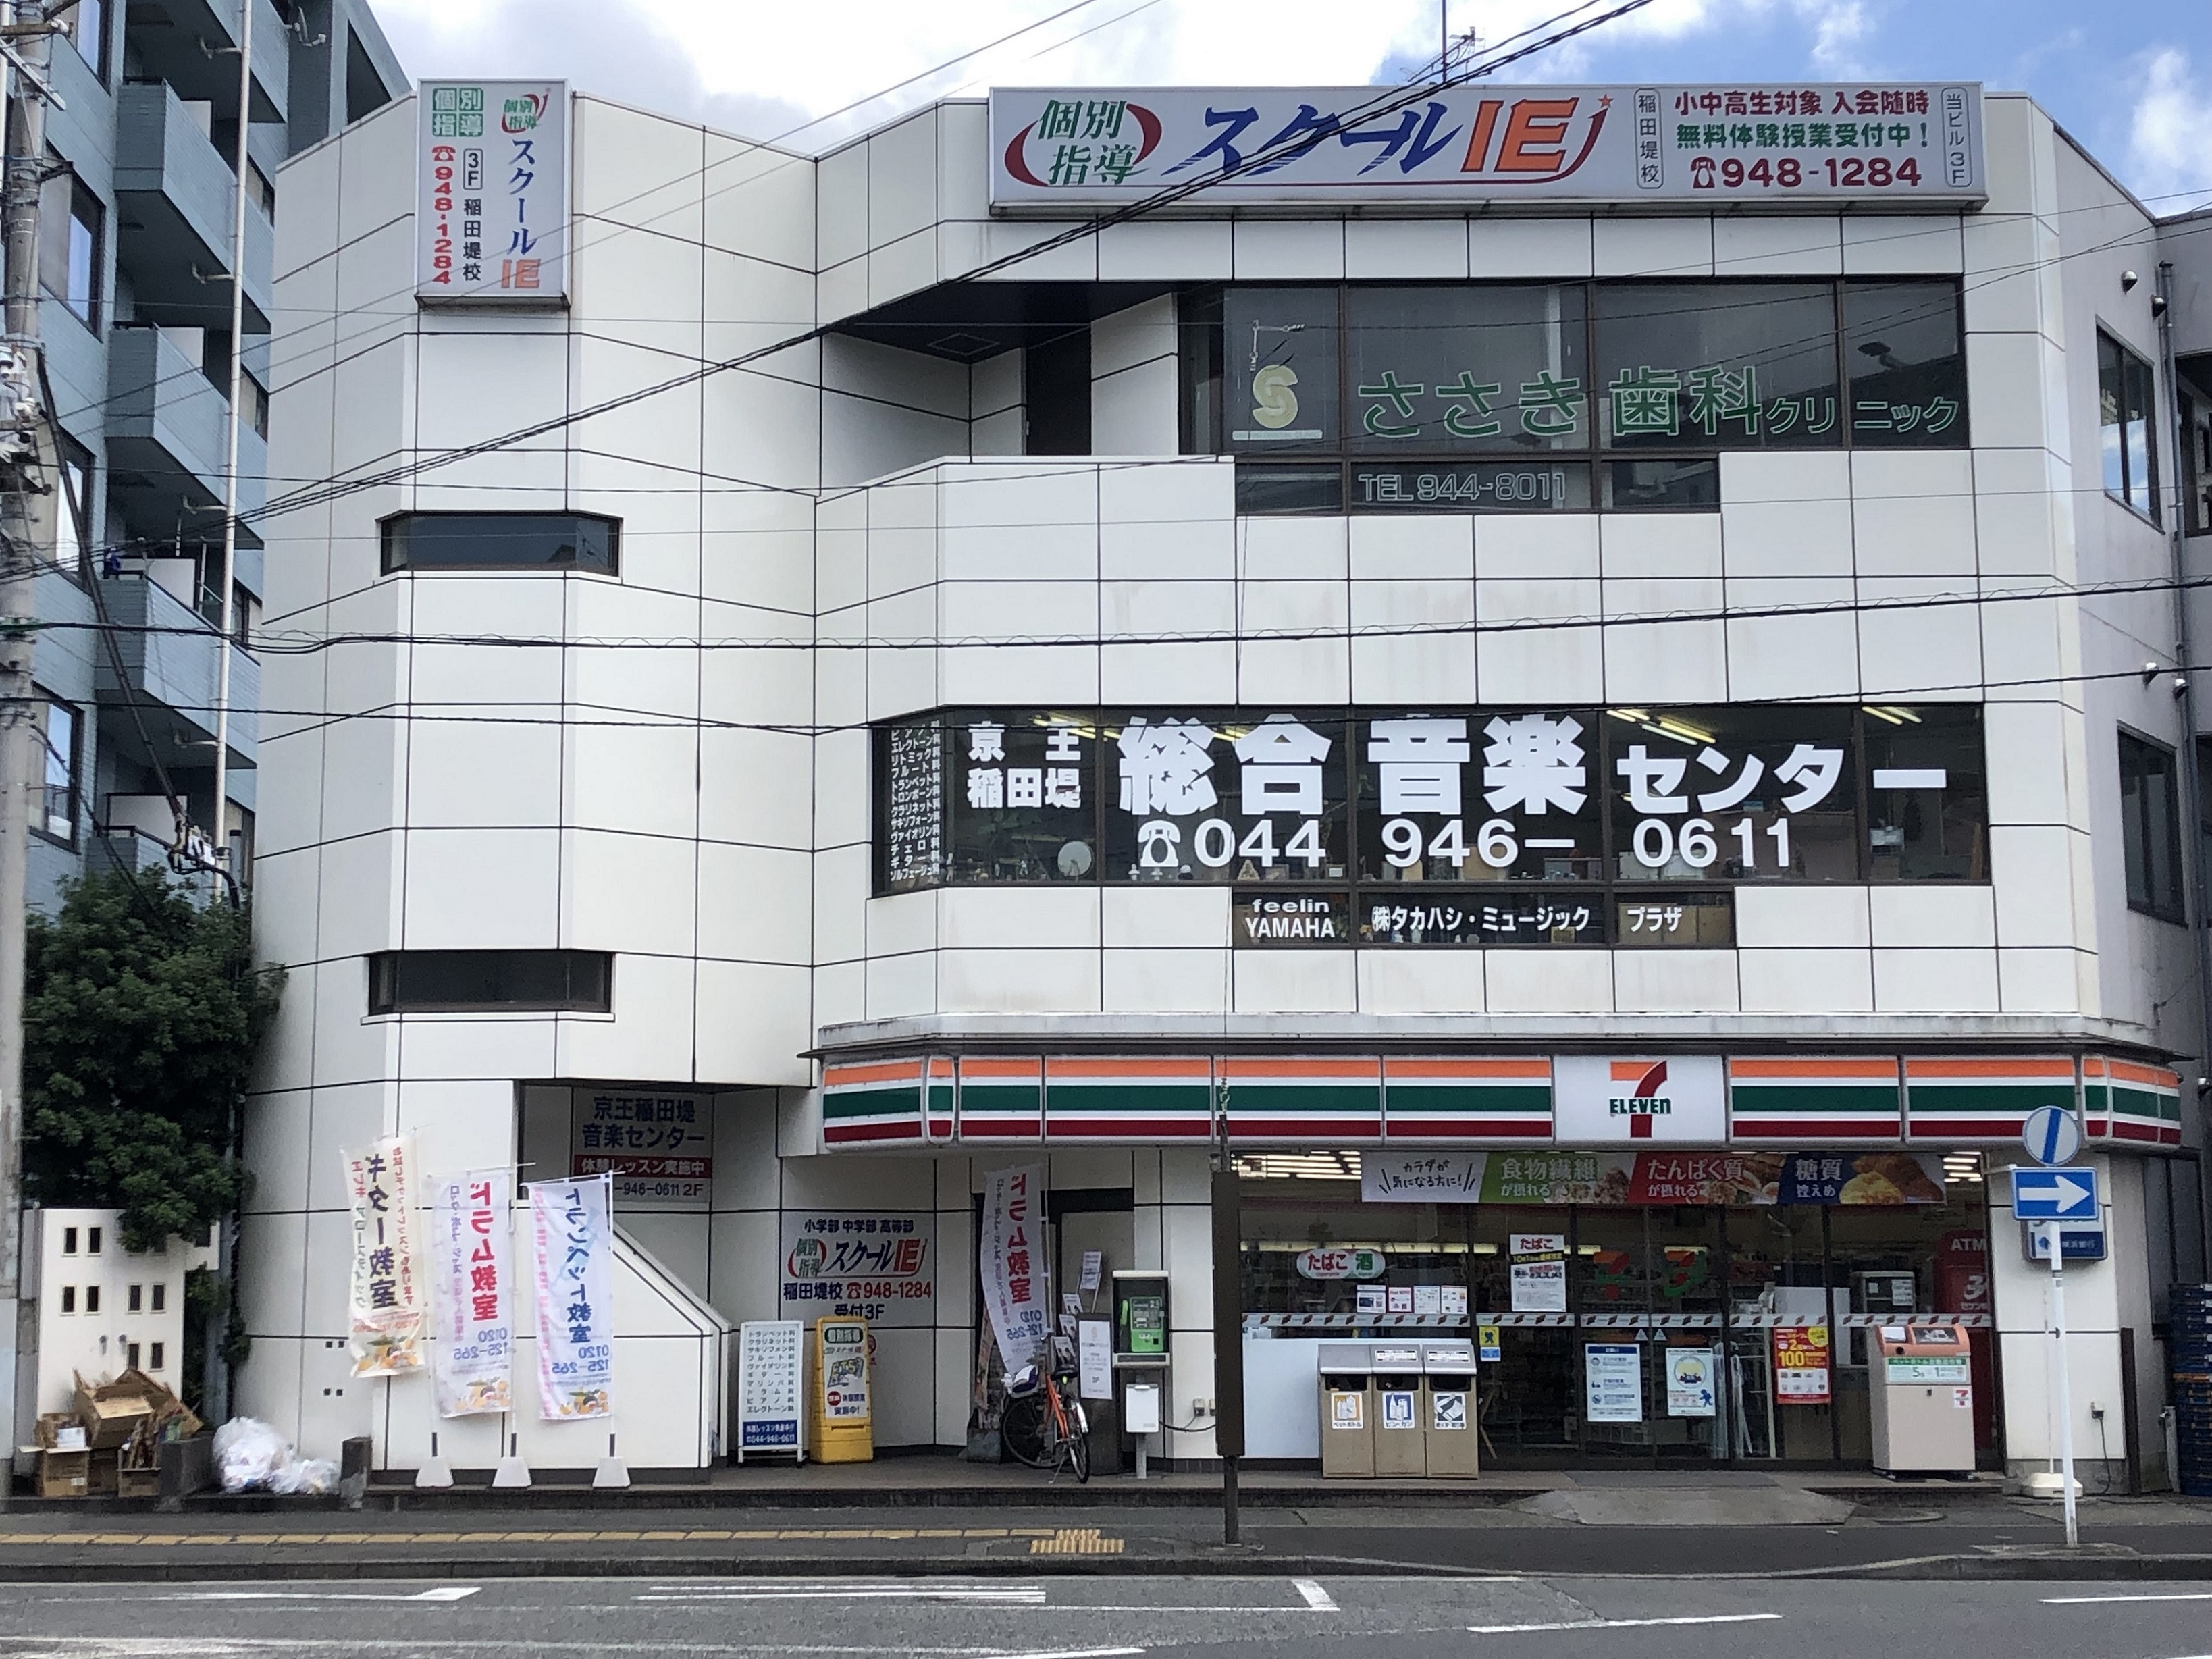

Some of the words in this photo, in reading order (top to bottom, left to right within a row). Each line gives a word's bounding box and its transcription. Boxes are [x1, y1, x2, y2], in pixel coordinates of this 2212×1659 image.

[433, 88, 483, 111] 個別
[1675, 90, 1823, 115] 小中高生対象
[1831, 90, 1930, 115] 入会随時
[433, 113, 483, 137] 指導
[1038, 99, 1127, 140] 個別
[1638, 95, 1660, 184] 稲田堤校
[1676, 122, 1930, 149] 無料体験授業受付中！
[1945, 93, 1966, 184] 当ビル3F
[467, 153, 481, 186] 3F
[1048, 144, 1142, 186] 指導
[1720, 157, 1922, 188] 948-1284
[463, 199, 482, 282] 稲田堤校
[1357, 473, 1414, 502] TEL
[1417, 473, 1566, 502] 944-8011
[967, 720, 1082, 762] 京王
[967, 768, 1082, 810] 稲田堤
[1252, 898, 1330, 914] feelin
[1627, 905, 1683, 933] プラザ
[1244, 918, 1336, 939] YAMAHA
[593, 1096, 696, 1124] 京王稲田堤
[582, 1124, 705, 1150] 音楽センター
[1500, 1158, 1598, 1182] 食物繊維
[1648, 1159, 1744, 1181] たんぱく質
[1795, 1158, 1844, 1182] 糖質
[683, 1183, 704, 1197] 2F
[804, 1219, 839, 1233] 小学部
[843, 1219, 877, 1233] 中学部
[1519, 1238, 1554, 1250] たばこ
[1307, 1253, 1348, 1271] たばこ
[1354, 1253, 1373, 1271] 酒
[783, 1282, 843, 1300] 稲田堤校
[864, 1282, 932, 1299] 948-1284
